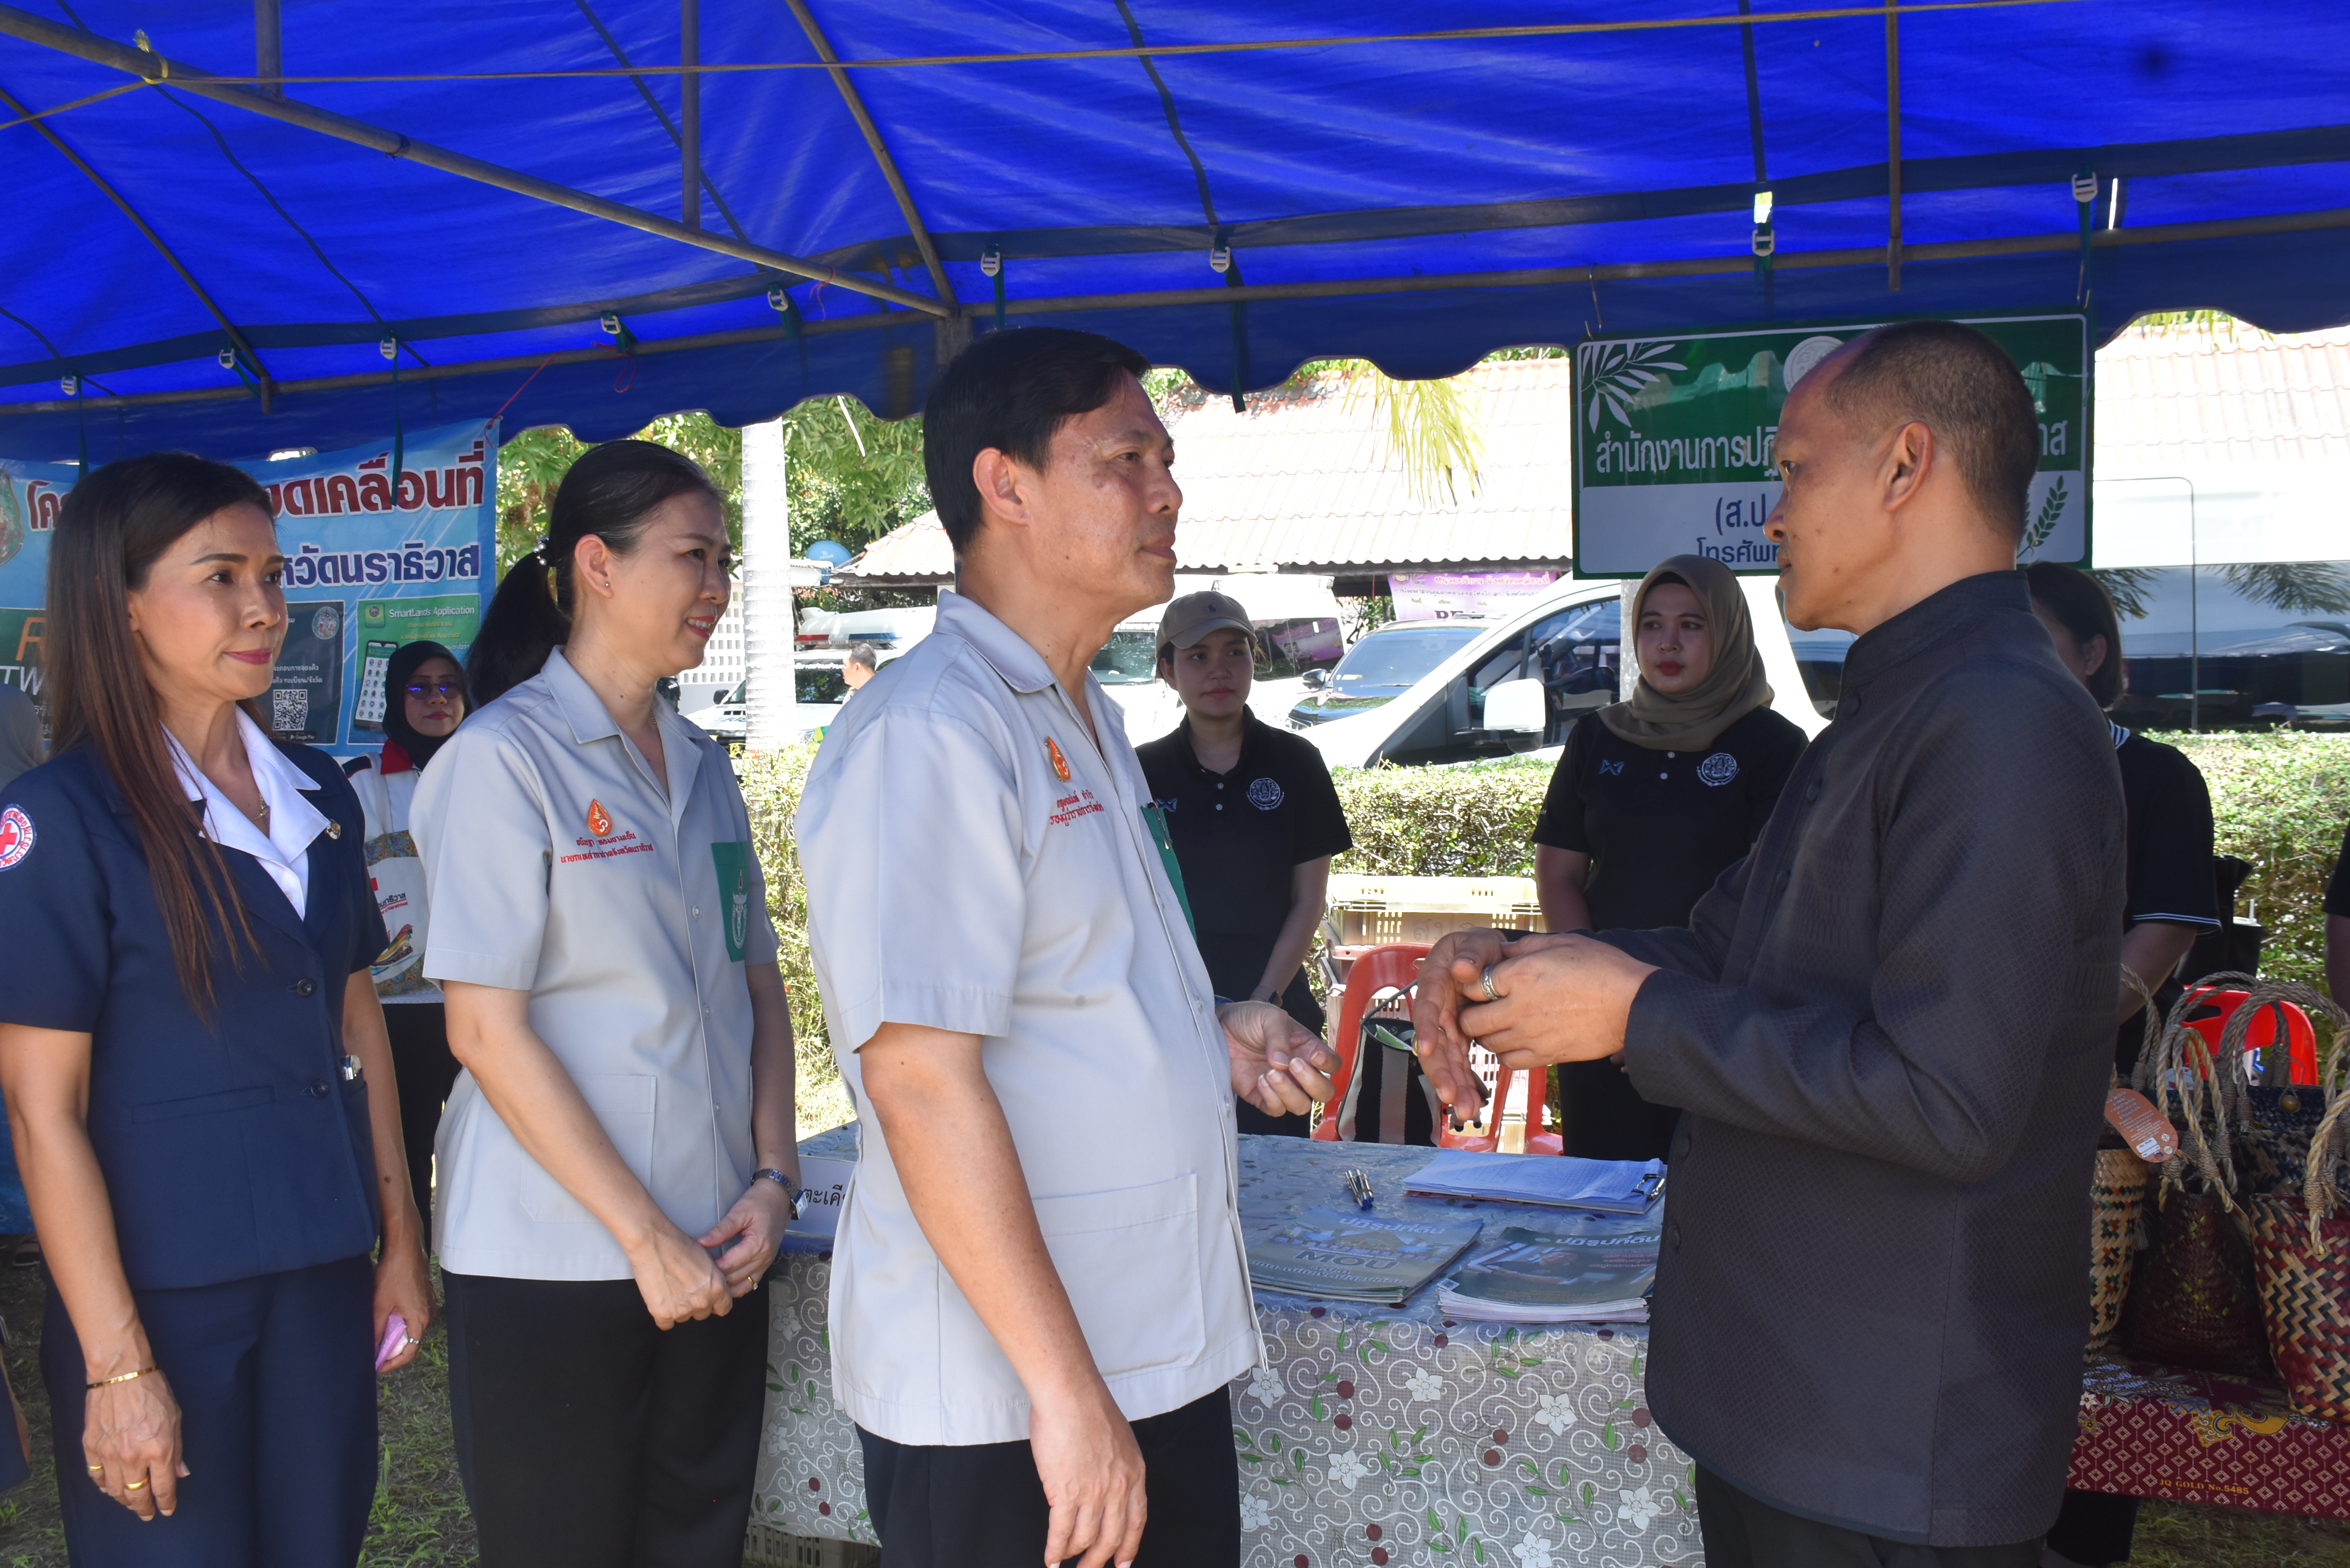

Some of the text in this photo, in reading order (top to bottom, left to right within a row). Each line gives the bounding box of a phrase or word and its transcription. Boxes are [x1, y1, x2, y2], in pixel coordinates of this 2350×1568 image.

[27, 481, 70, 529] โค
[389, 606, 475, 618] SmartLands Application
[803, 1184, 846, 1206] ตะเคี
[1294, 1250, 1399, 1270] MOU
[2175, 1481, 2204, 1490] GOLD
[2208, 1484, 2249, 1495] No.5485
